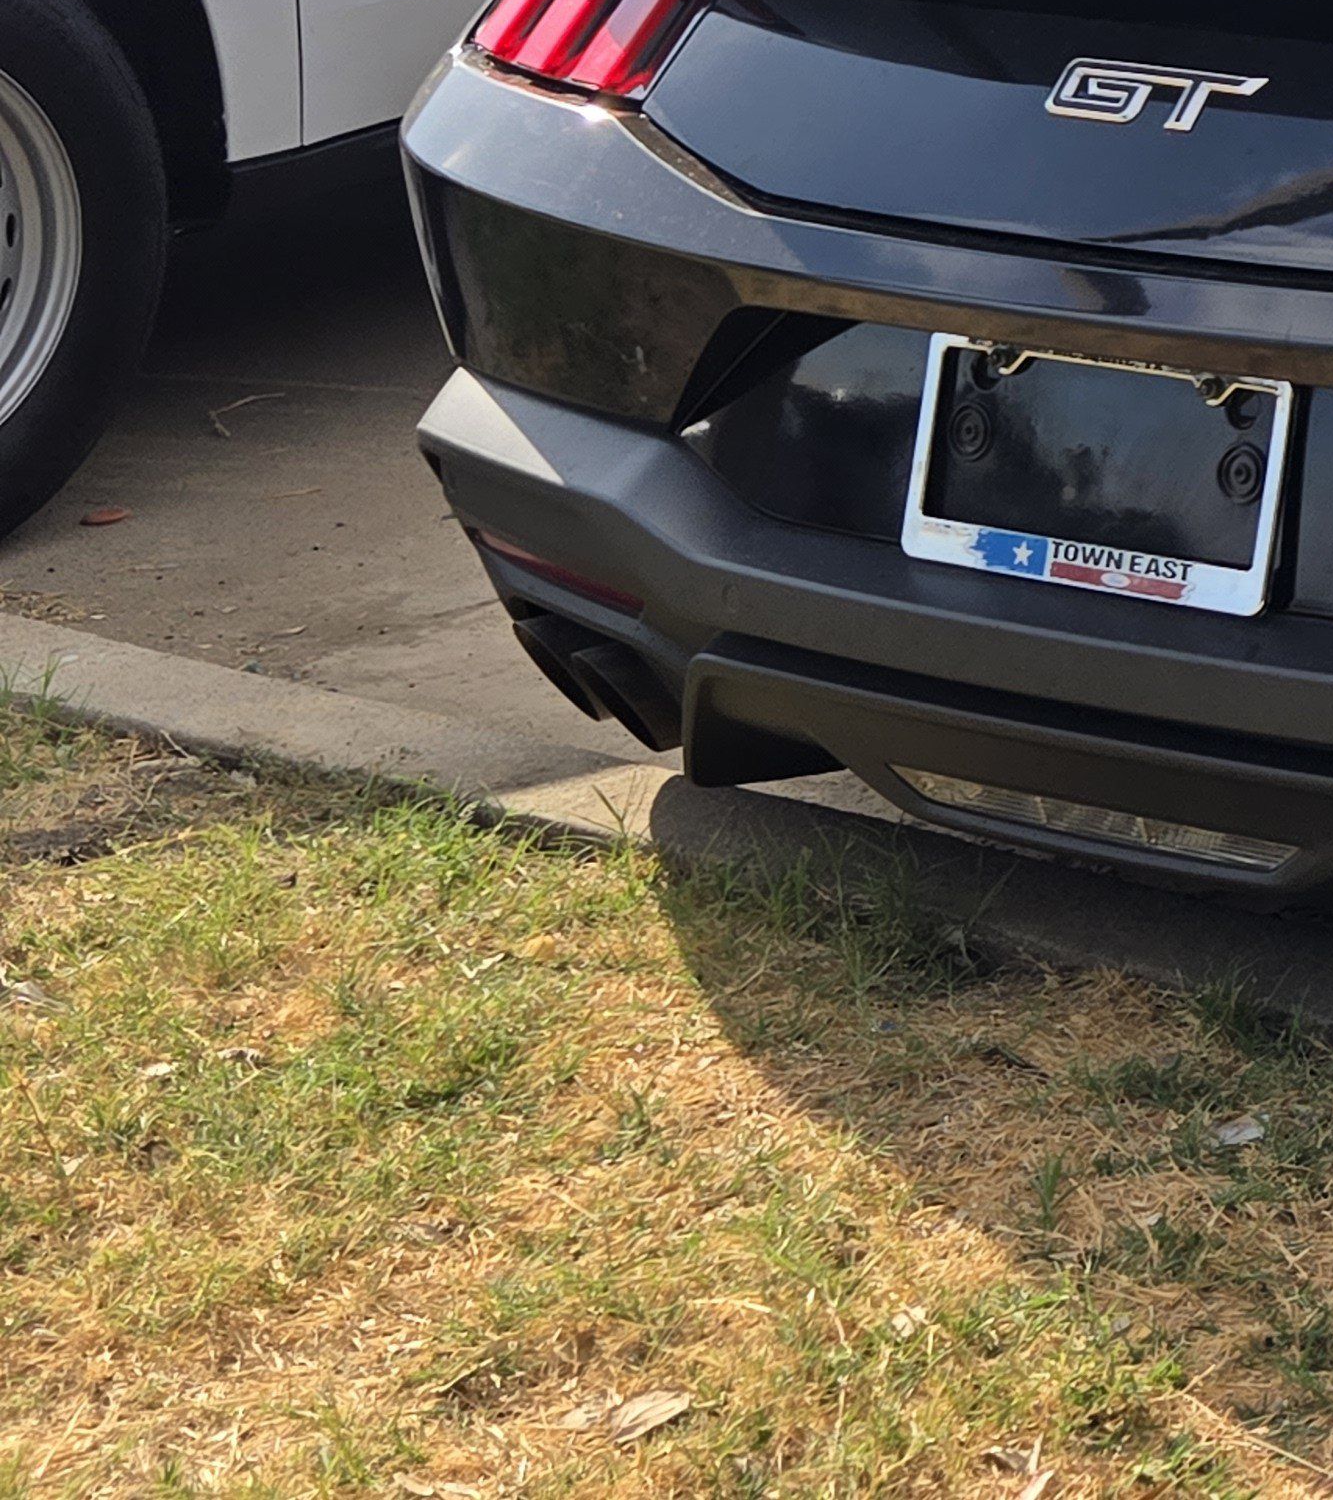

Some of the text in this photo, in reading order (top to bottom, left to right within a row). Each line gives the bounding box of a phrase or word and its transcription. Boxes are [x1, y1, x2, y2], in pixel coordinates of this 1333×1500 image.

[1044, 56, 1270, 132] GT
[1052, 541, 1123, 570] TOWN
[1129, 554, 1194, 581] EAST
